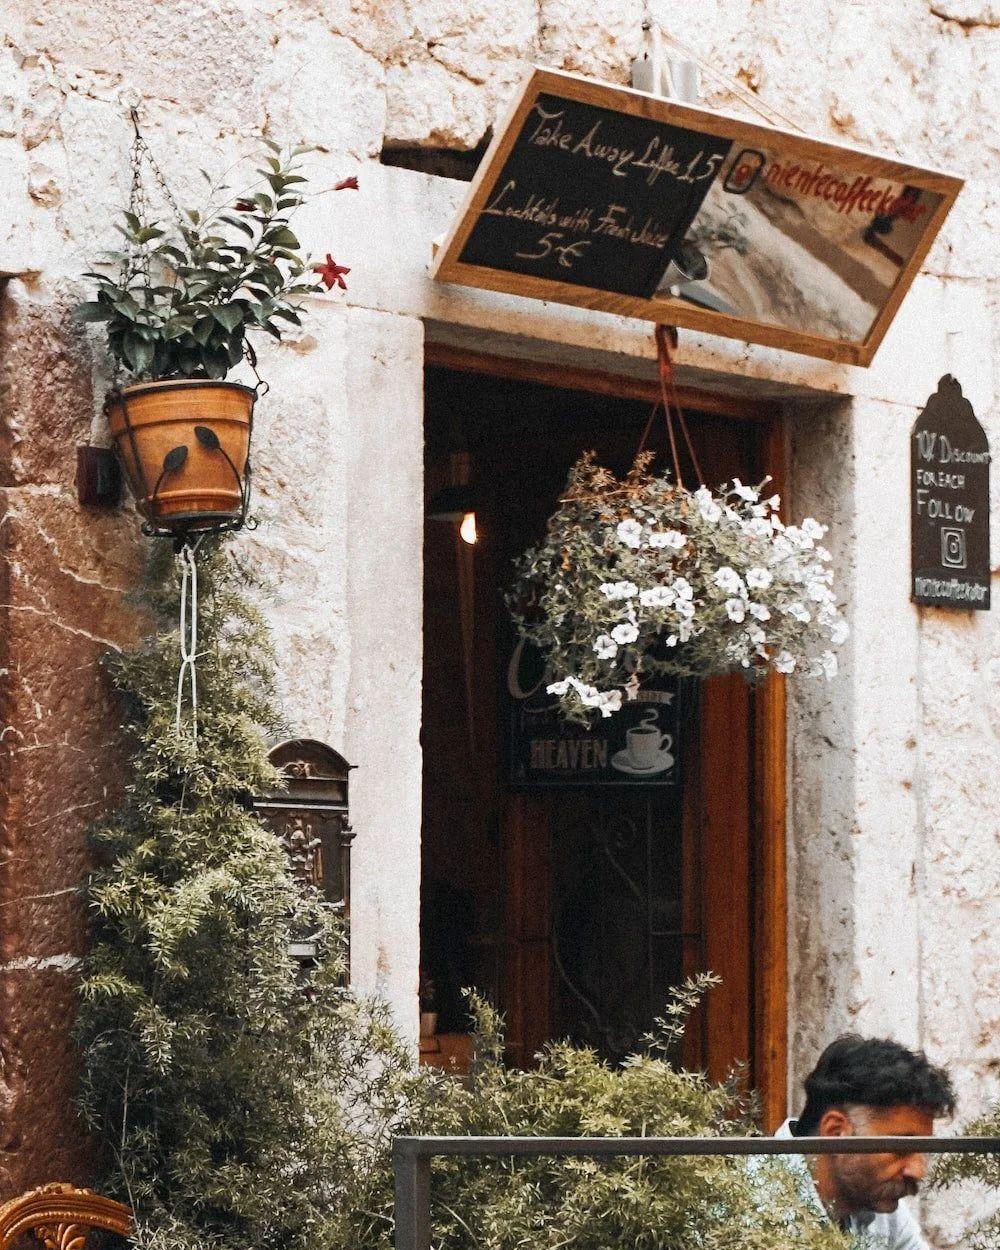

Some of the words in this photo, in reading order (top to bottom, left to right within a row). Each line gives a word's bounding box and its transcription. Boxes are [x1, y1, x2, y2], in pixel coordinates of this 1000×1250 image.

[529, 102, 574, 149] Take
[572, 119, 635, 177] Away
[531, 739, 608, 769] HEAVEN
